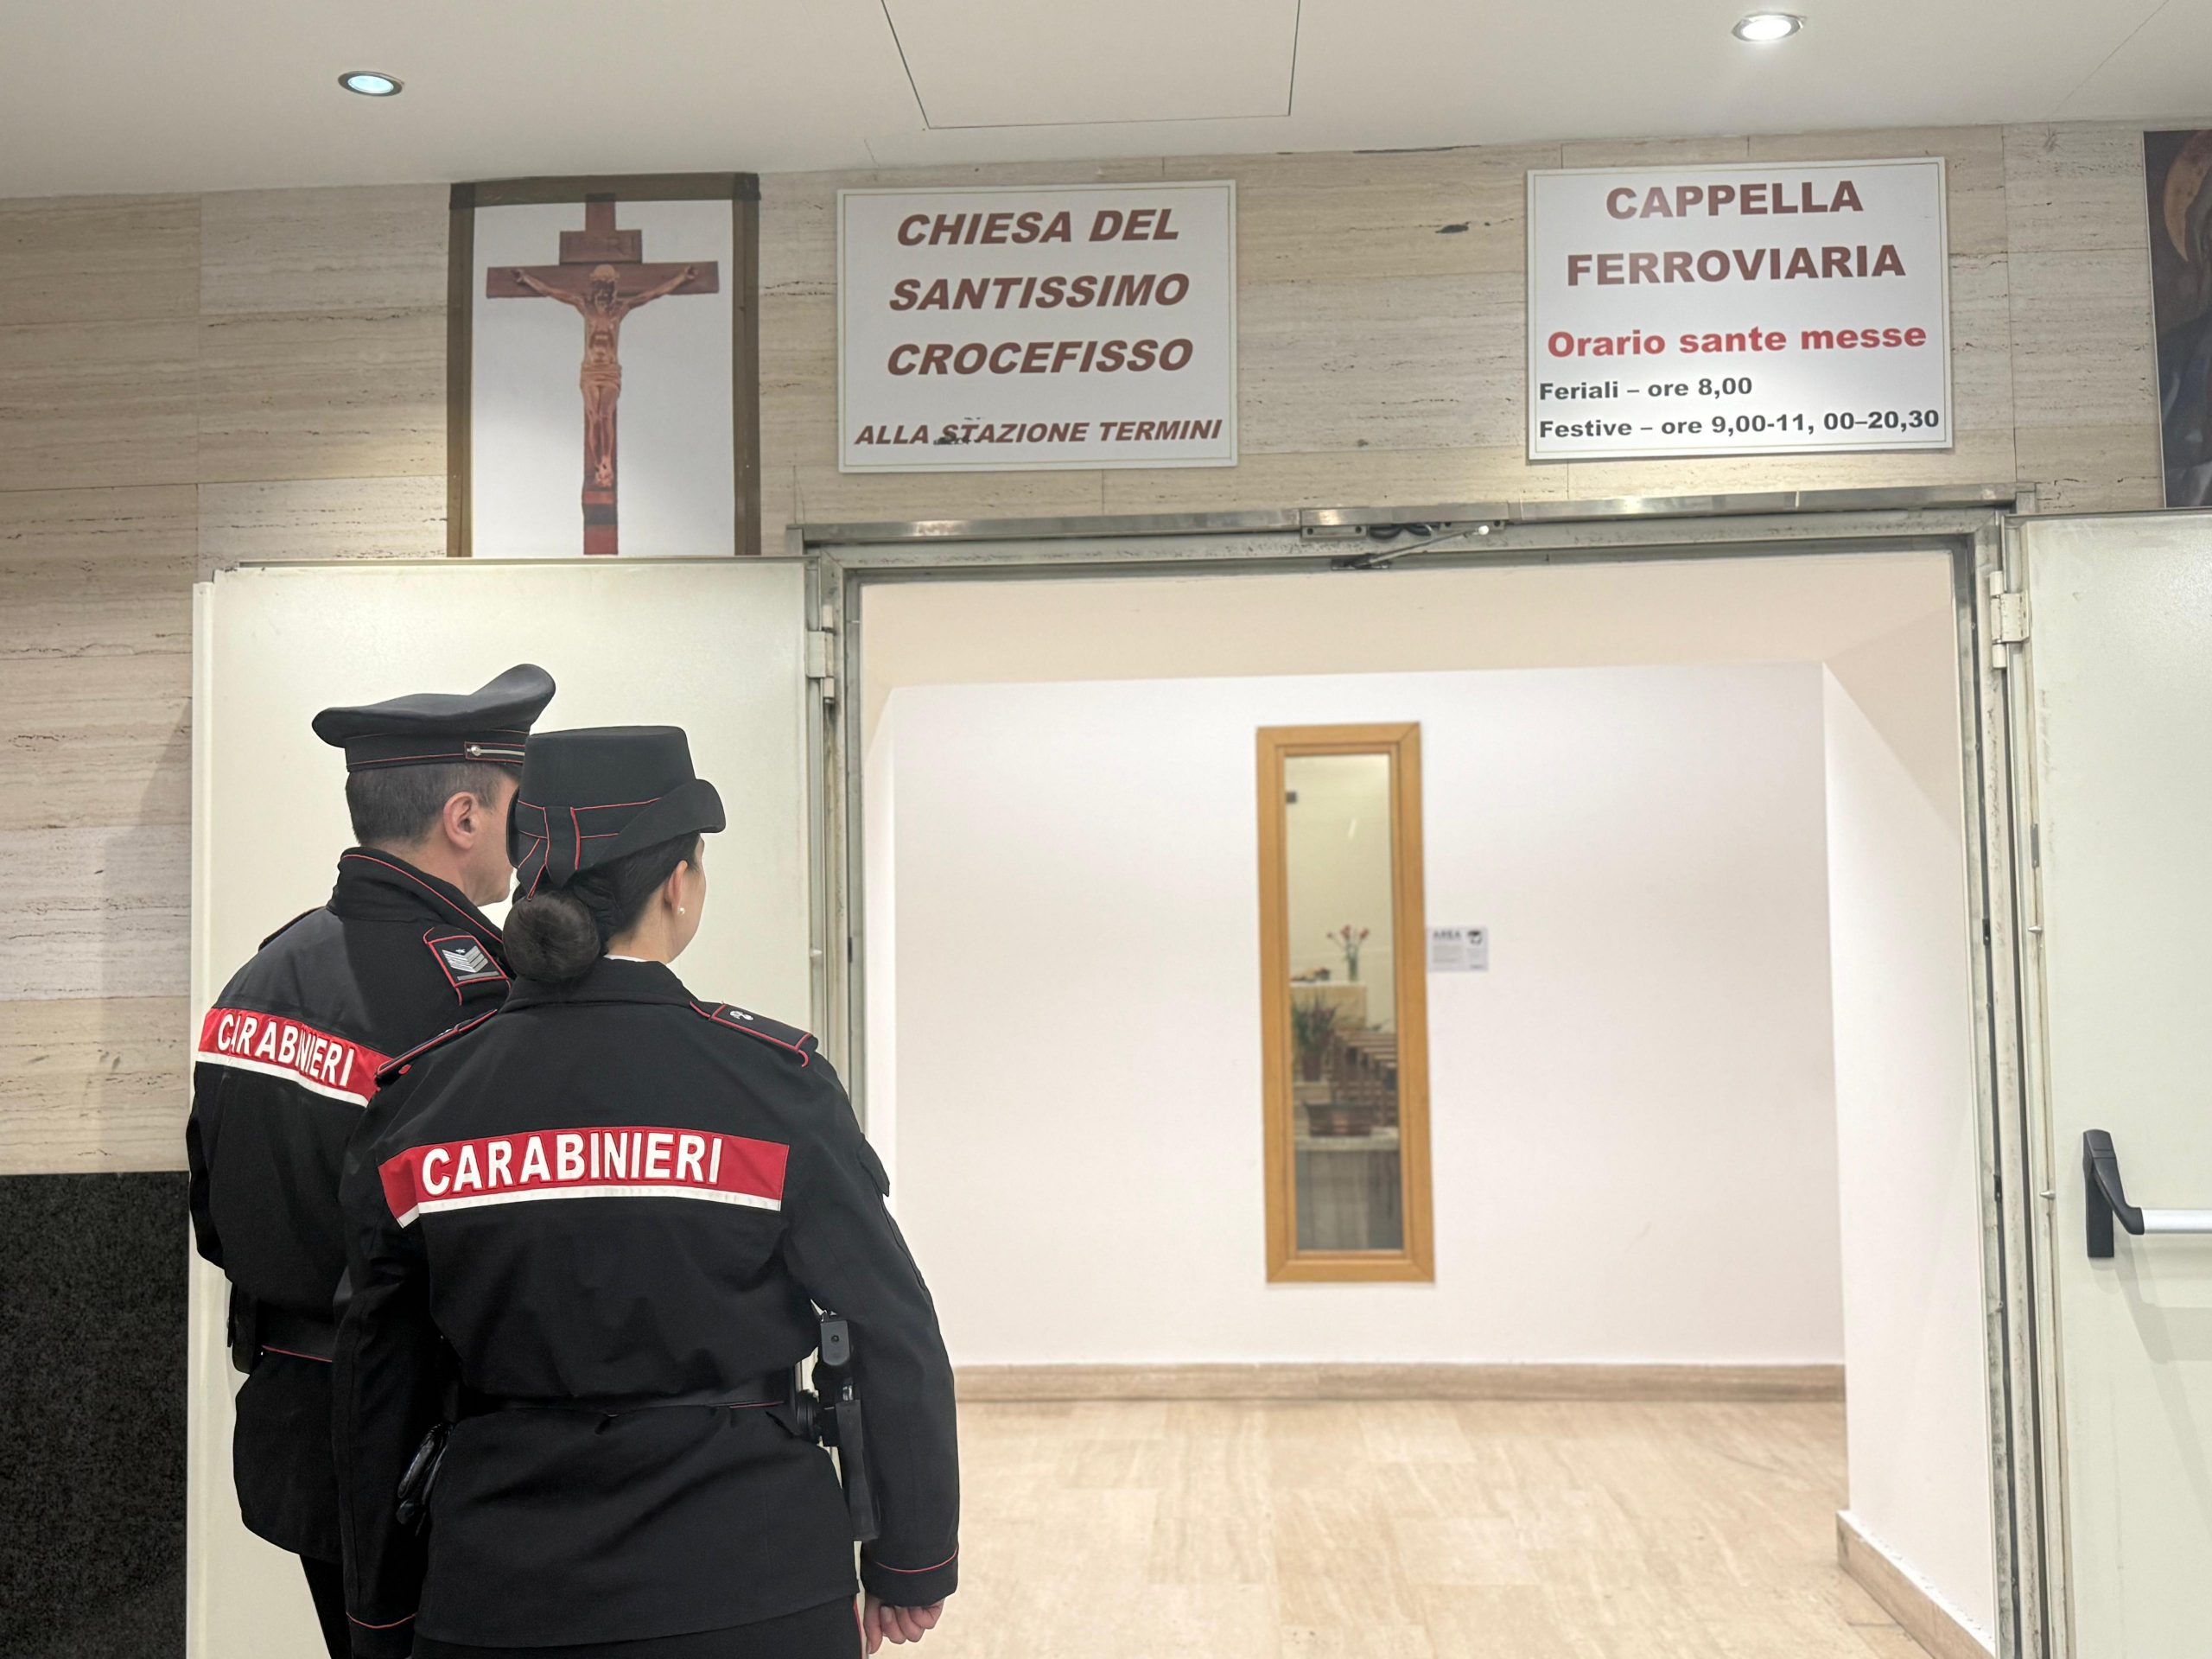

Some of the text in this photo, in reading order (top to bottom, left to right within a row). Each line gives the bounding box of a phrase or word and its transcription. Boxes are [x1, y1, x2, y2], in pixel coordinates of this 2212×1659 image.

[1606, 180, 1864, 219] CAPPELLA
[897, 208, 1180, 247] CHIESA DEL
[1567, 244, 1907, 286] FERROVIARIA
[889, 273, 1190, 312] SANTISSIMO
[887, 338, 1193, 377] CROCEFISSO
[1548, 327, 1928, 359] Orario sante messe
[1539, 381, 1618, 400] Feriali
[1647, 384, 1689, 397] ore
[1698, 377, 1752, 400] 8,00
[854, 419, 1223, 445] ALLA STAZIONE TERMINI
[1539, 419, 1633, 438] Festive
[1661, 421, 1703, 435] ore
[217, 1013, 355, 1087] CARABINIERI
[421, 1132, 725, 1196] CARABINIERI
